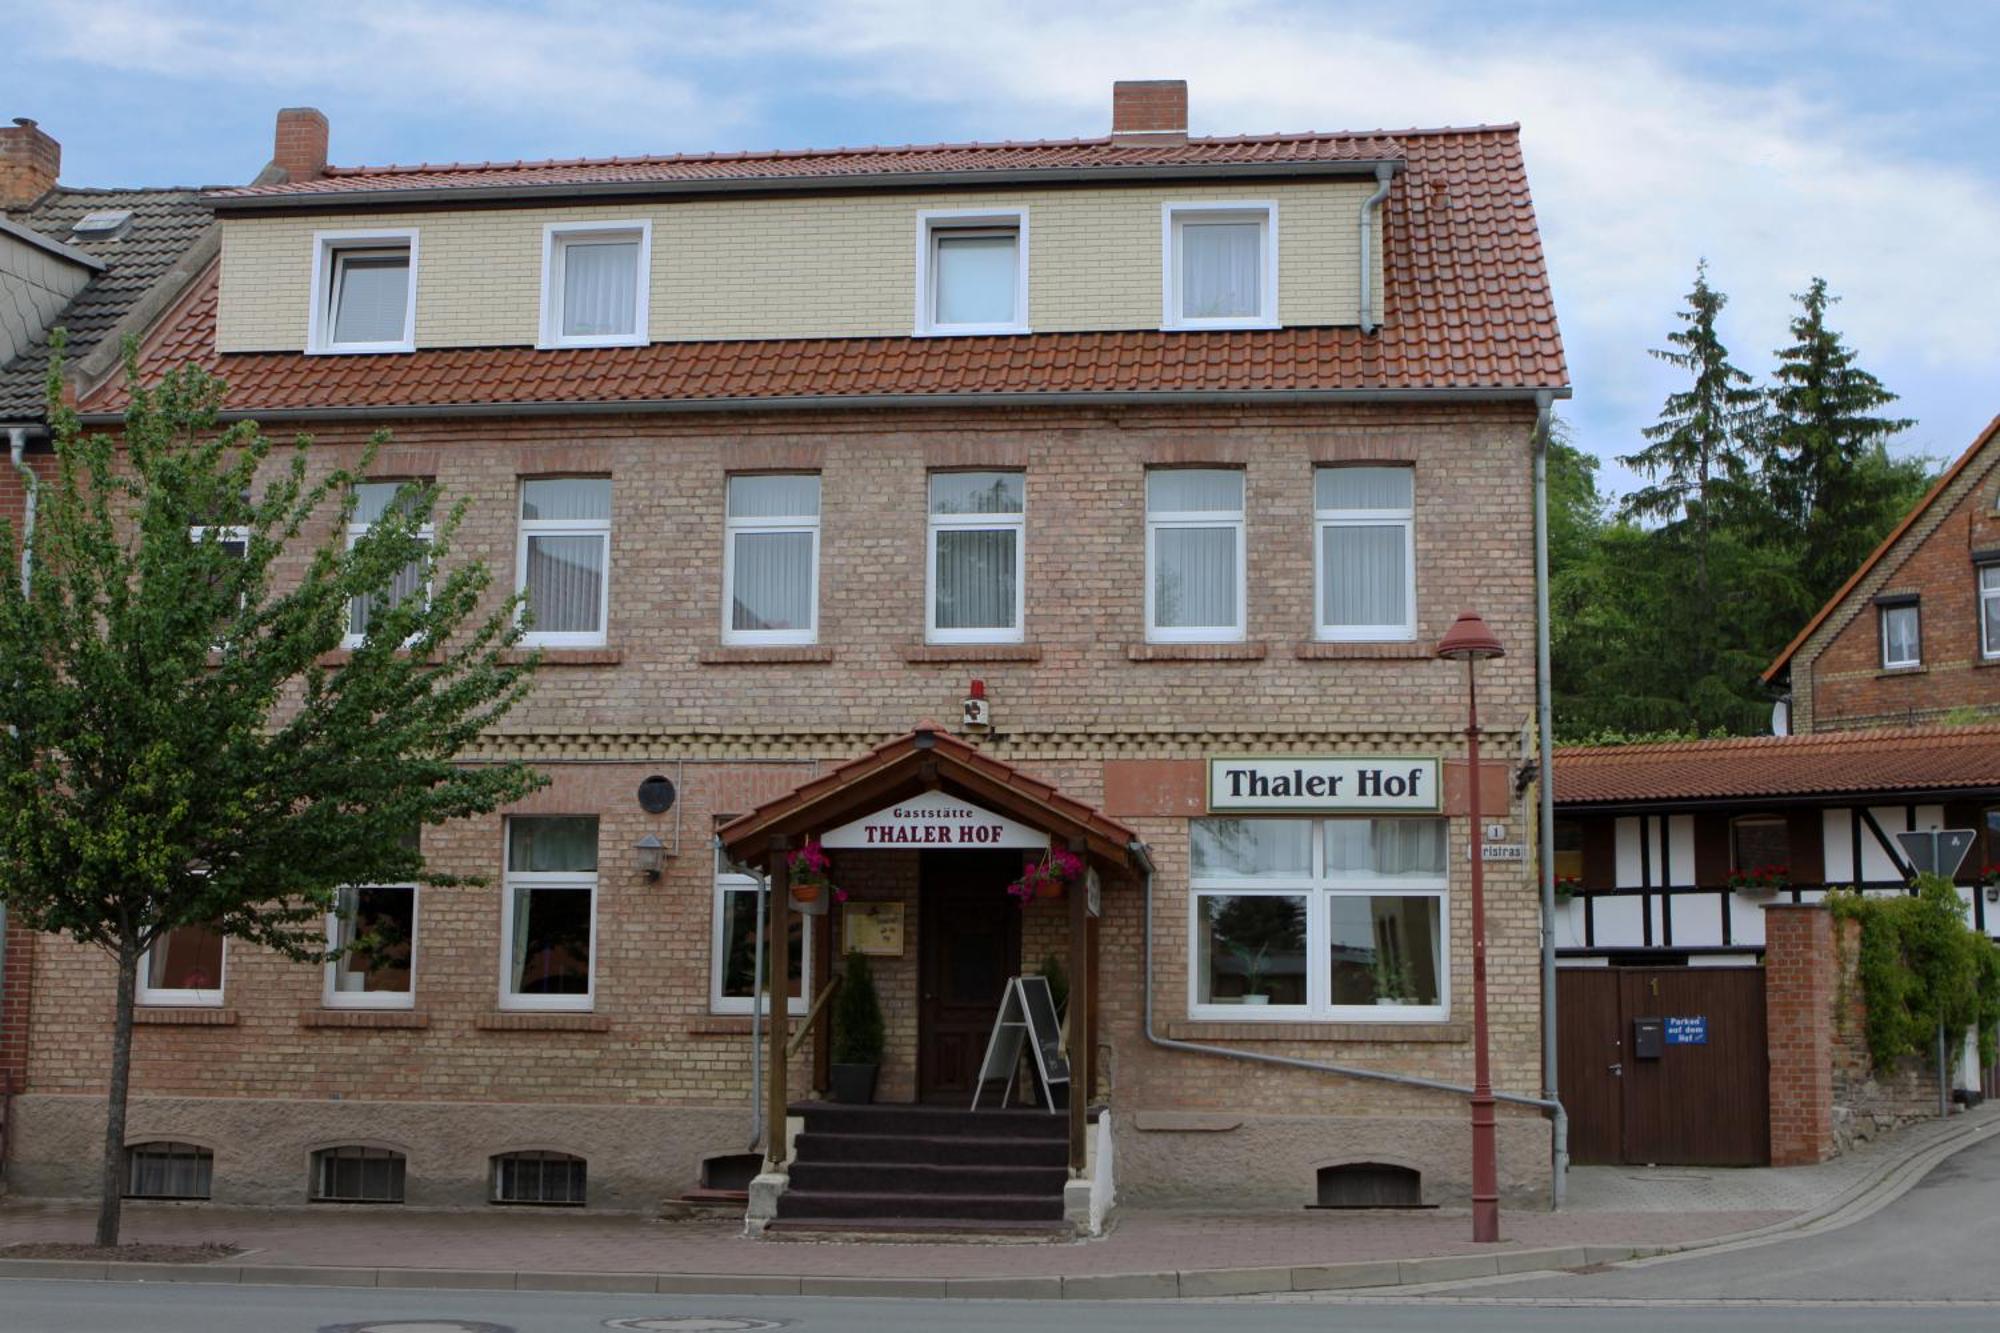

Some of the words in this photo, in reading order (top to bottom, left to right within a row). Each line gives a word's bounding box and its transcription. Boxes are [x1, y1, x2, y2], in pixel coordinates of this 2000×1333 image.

[1225, 769, 1343, 797] Thaler
[1357, 768, 1423, 797] Hof
[893, 808, 973, 818] Gaststätte
[865, 825, 952, 843] THALER
[958, 825, 1004, 843] HOF
[1492, 827, 1498, 838] 1
[1651, 978, 1658, 995] 1
